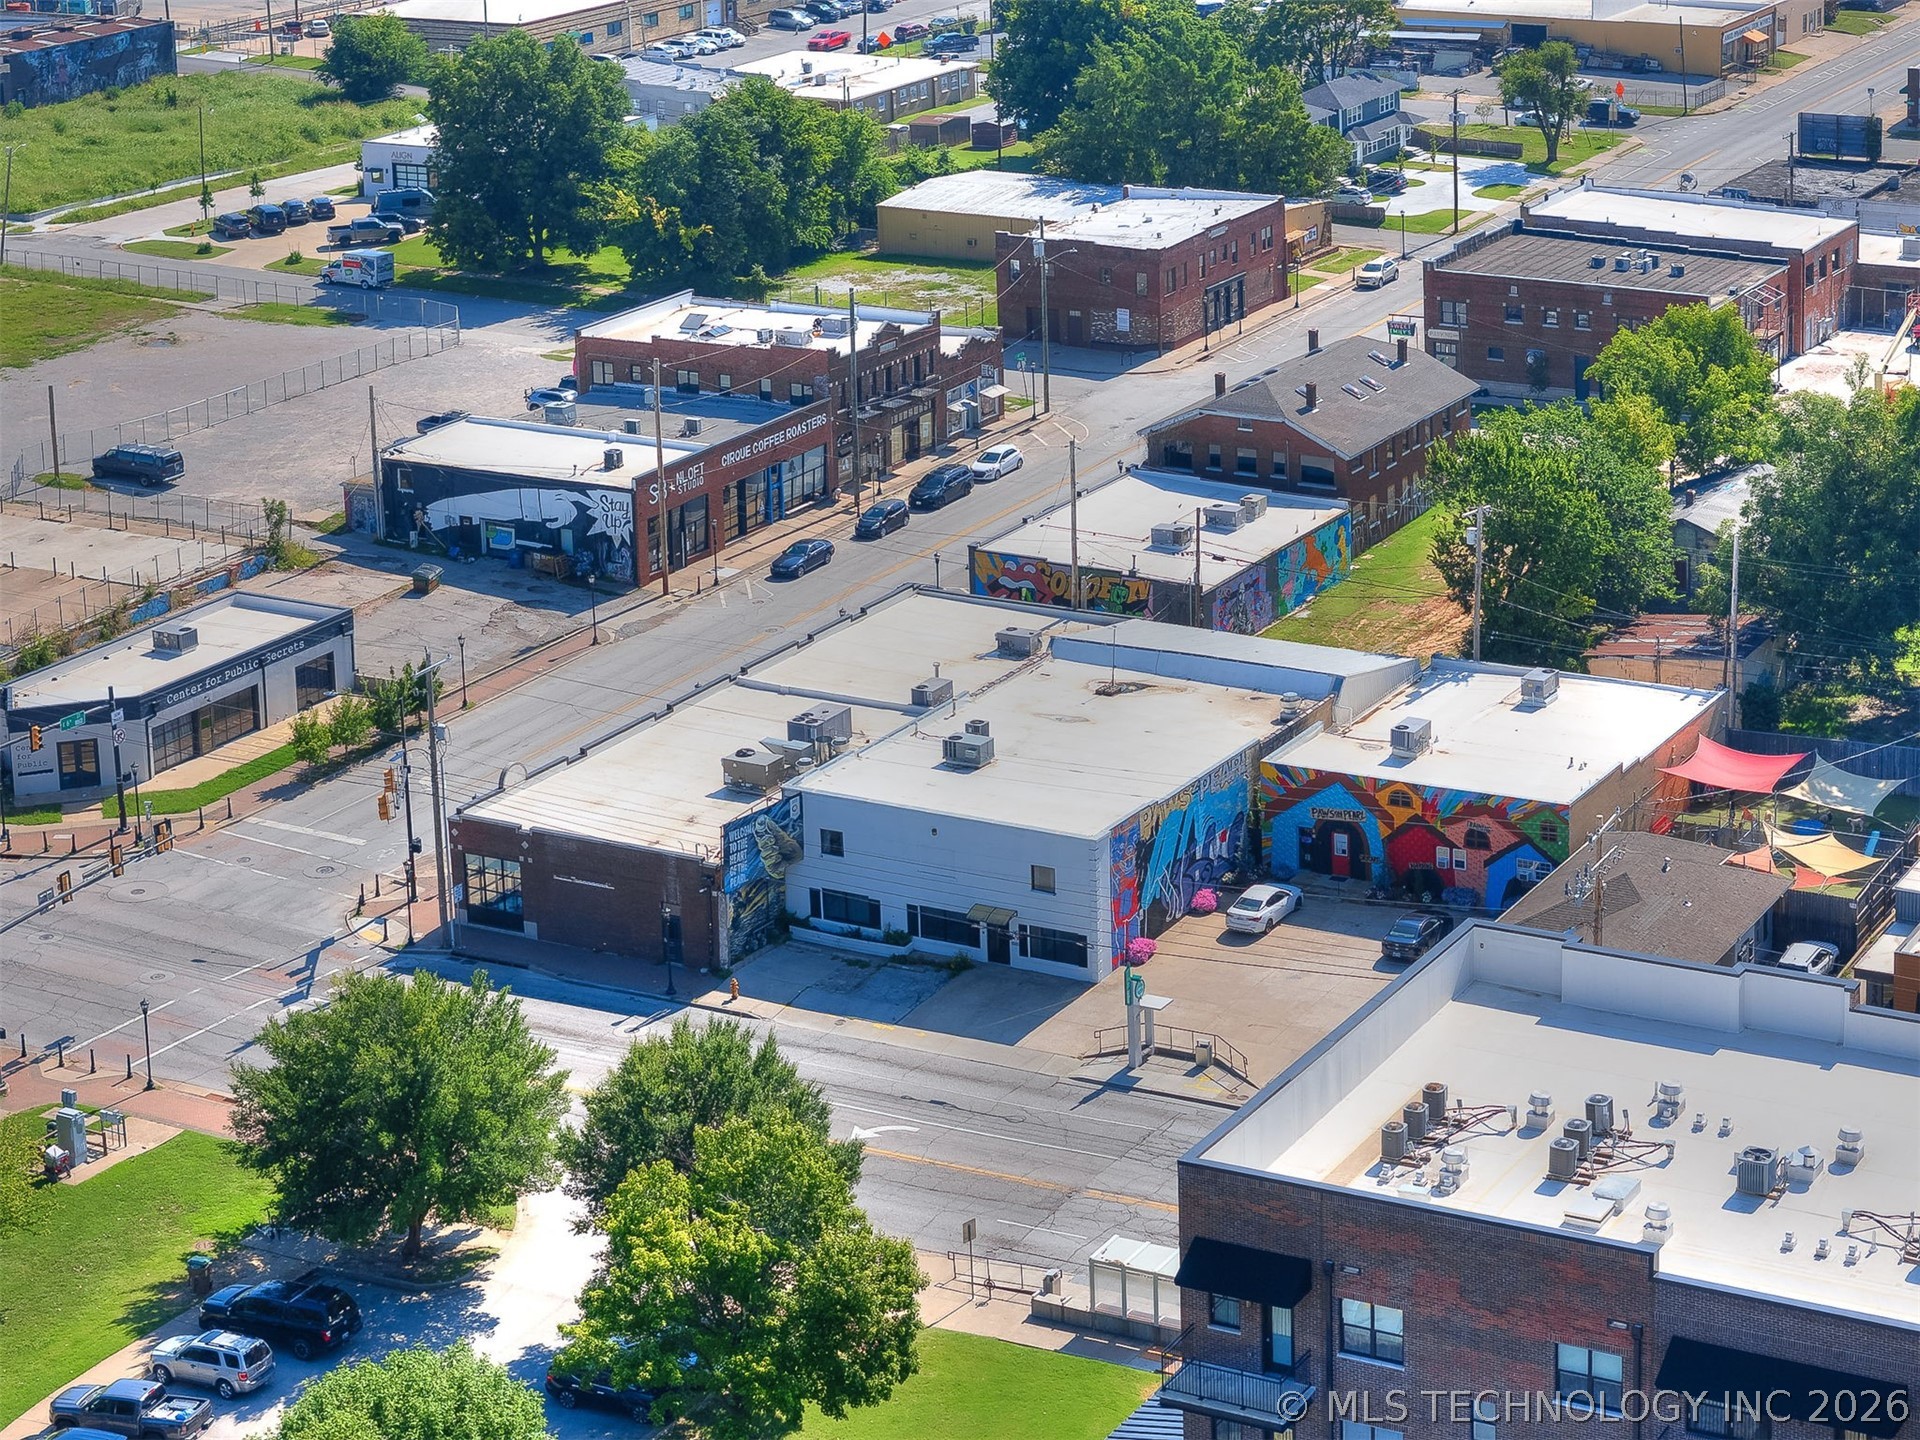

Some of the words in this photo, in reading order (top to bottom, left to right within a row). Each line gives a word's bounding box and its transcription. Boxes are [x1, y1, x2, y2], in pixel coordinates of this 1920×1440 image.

[721, 445, 752, 467] CIRQUE
[752, 431, 785, 455] COFFEE
[786, 413, 827, 441] ROASTERS
[678, 475, 704, 495] STUDIO
[600, 494, 630, 520] Stay
[166, 681, 203, 705] Center
[205, 674, 222, 689] for
[224, 658, 260, 681] Public
[262, 640, 305, 665] Secrets
[17, 760, 49, 769] Public
[729, 822, 755, 842] WELCOME
[729, 842, 738, 854] TO
[737, 837, 748, 851] THE
[729, 849, 748, 866] HEART
